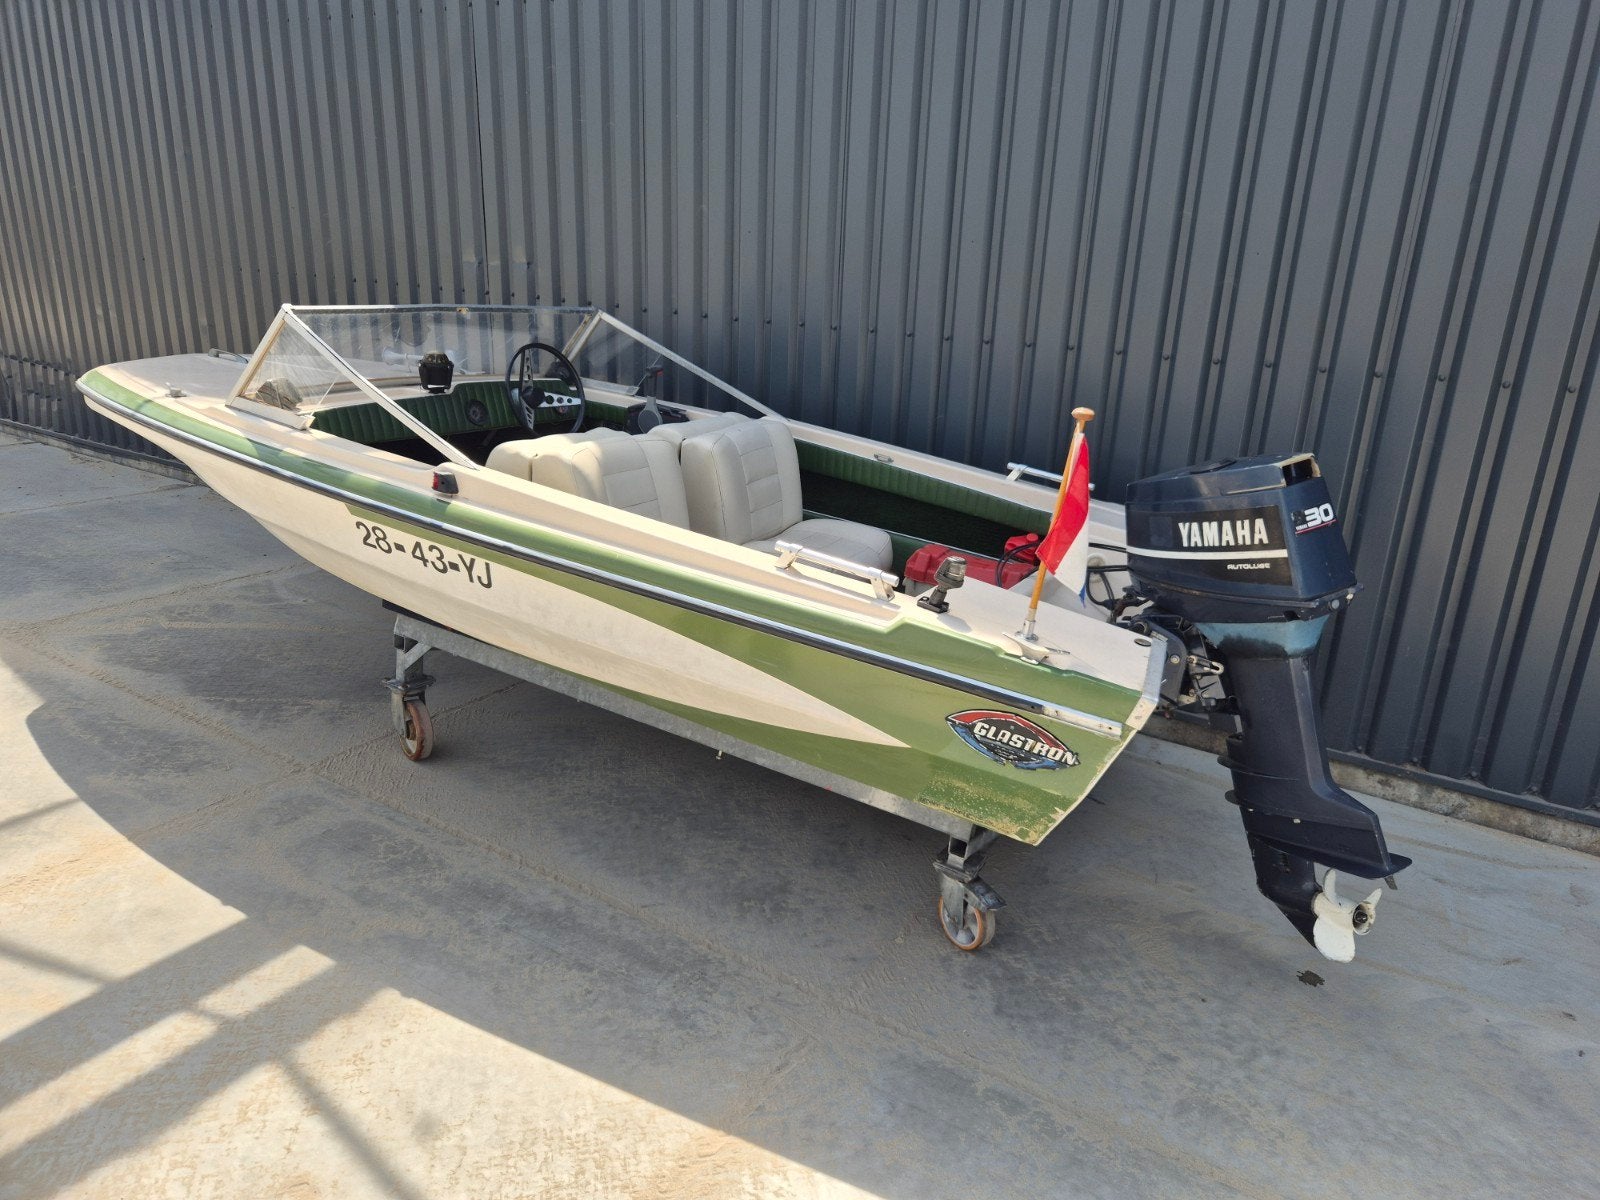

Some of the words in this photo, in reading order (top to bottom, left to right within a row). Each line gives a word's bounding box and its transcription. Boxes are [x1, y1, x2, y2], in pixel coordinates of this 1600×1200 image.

[1304, 502, 1335, 528] 30
[1178, 518, 1269, 548] YAMAHA
[973, 722, 1079, 766] GLASTRON
